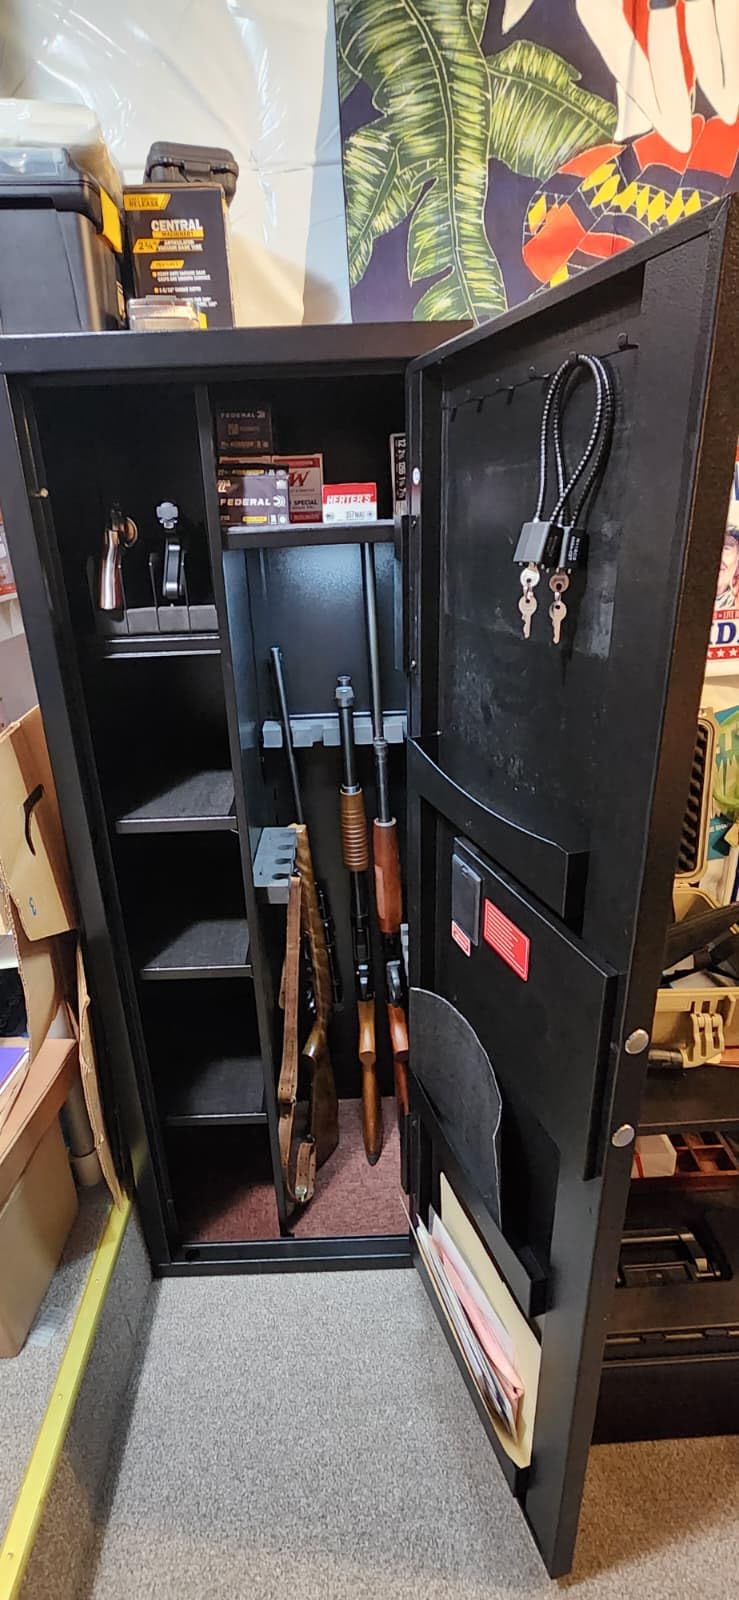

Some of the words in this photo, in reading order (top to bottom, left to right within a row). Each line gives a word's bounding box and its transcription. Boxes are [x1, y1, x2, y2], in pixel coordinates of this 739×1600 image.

[151, 219, 203, 231] CENTRAL
[220, 498, 272, 506] FEDERAL
[326, 494, 372, 505] HERTER'S
